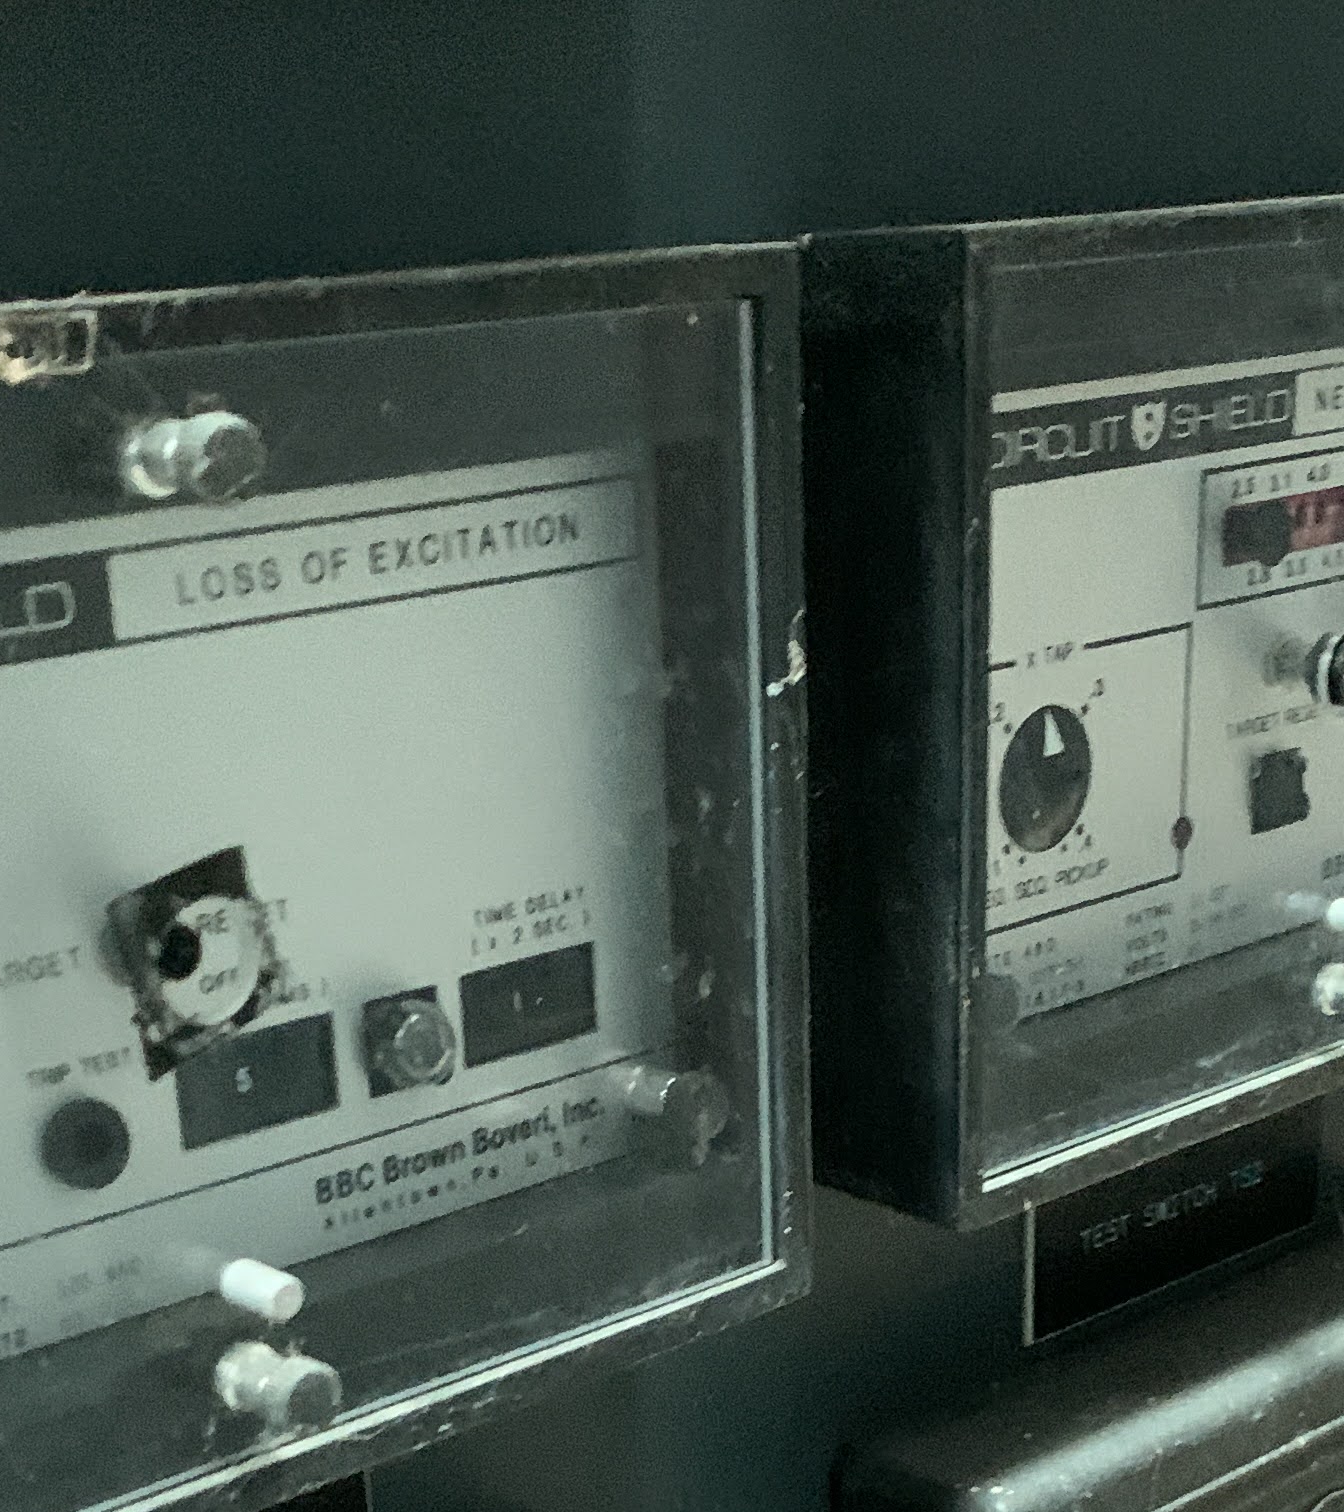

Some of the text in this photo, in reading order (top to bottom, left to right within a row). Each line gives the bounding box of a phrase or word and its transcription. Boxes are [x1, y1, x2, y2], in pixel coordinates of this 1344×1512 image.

[1169, 390, 1292, 440] SHIELD
[174, 511, 580, 606] LOSS OF EXCITATION
[473, 886, 584, 928] TIME DELAY
[78, 1047, 131, 1076] TEST
[315, 1162, 376, 1205] BBC
[383, 1141, 466, 1185] Brown
[471, 1106, 556, 1156] Boveri,
[1079, 1213, 1132, 1250] TEST
[1143, 1183, 1218, 1227] SWITCH
